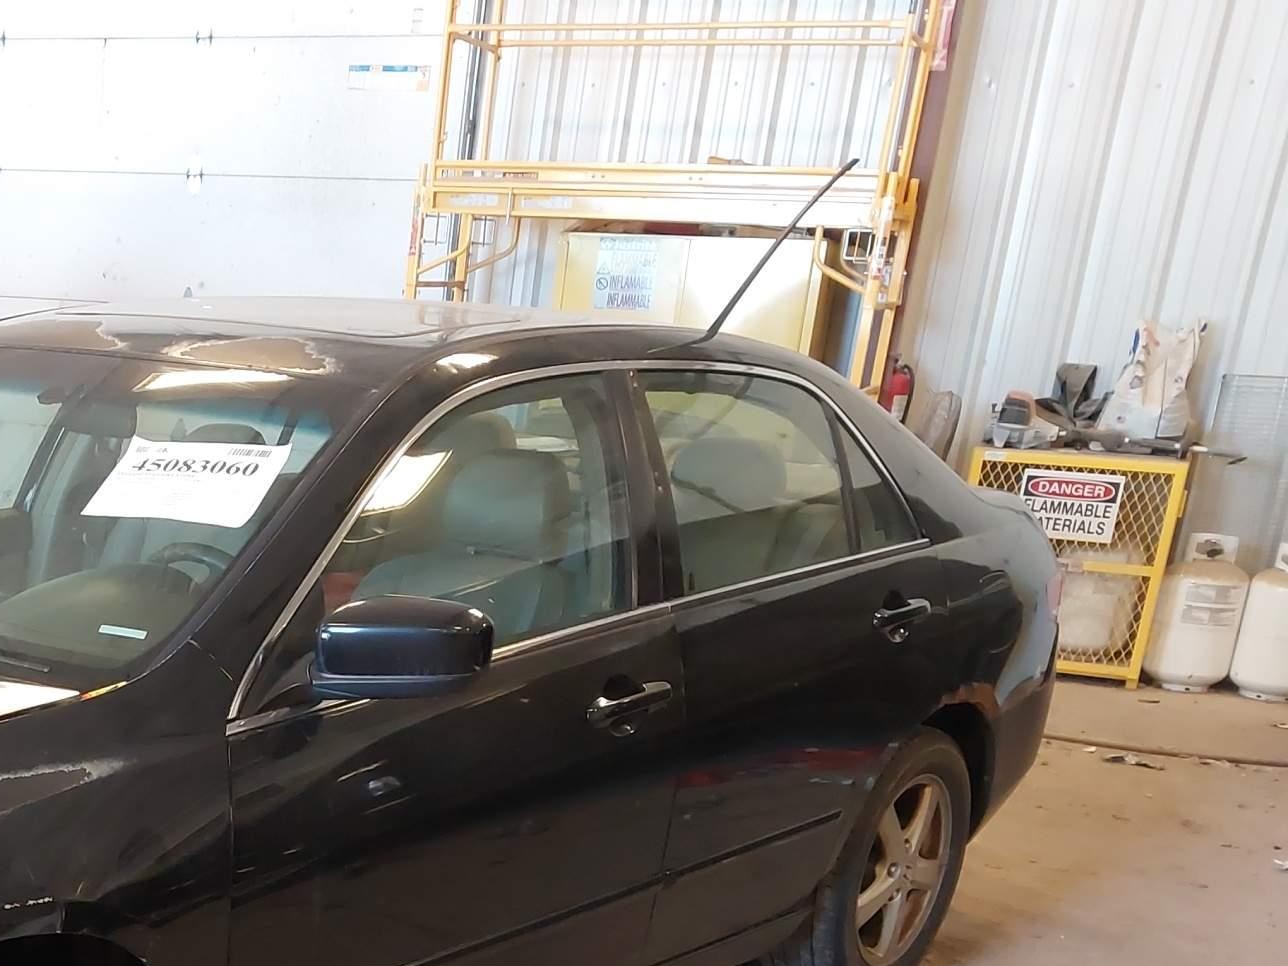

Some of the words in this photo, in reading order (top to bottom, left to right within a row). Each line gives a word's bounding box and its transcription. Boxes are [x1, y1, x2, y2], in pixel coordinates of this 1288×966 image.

[132, 457, 260, 477] 45083060
[1038, 481, 1106, 498] DANGER
[1024, 498, 1113, 519] FLAMMABLE
